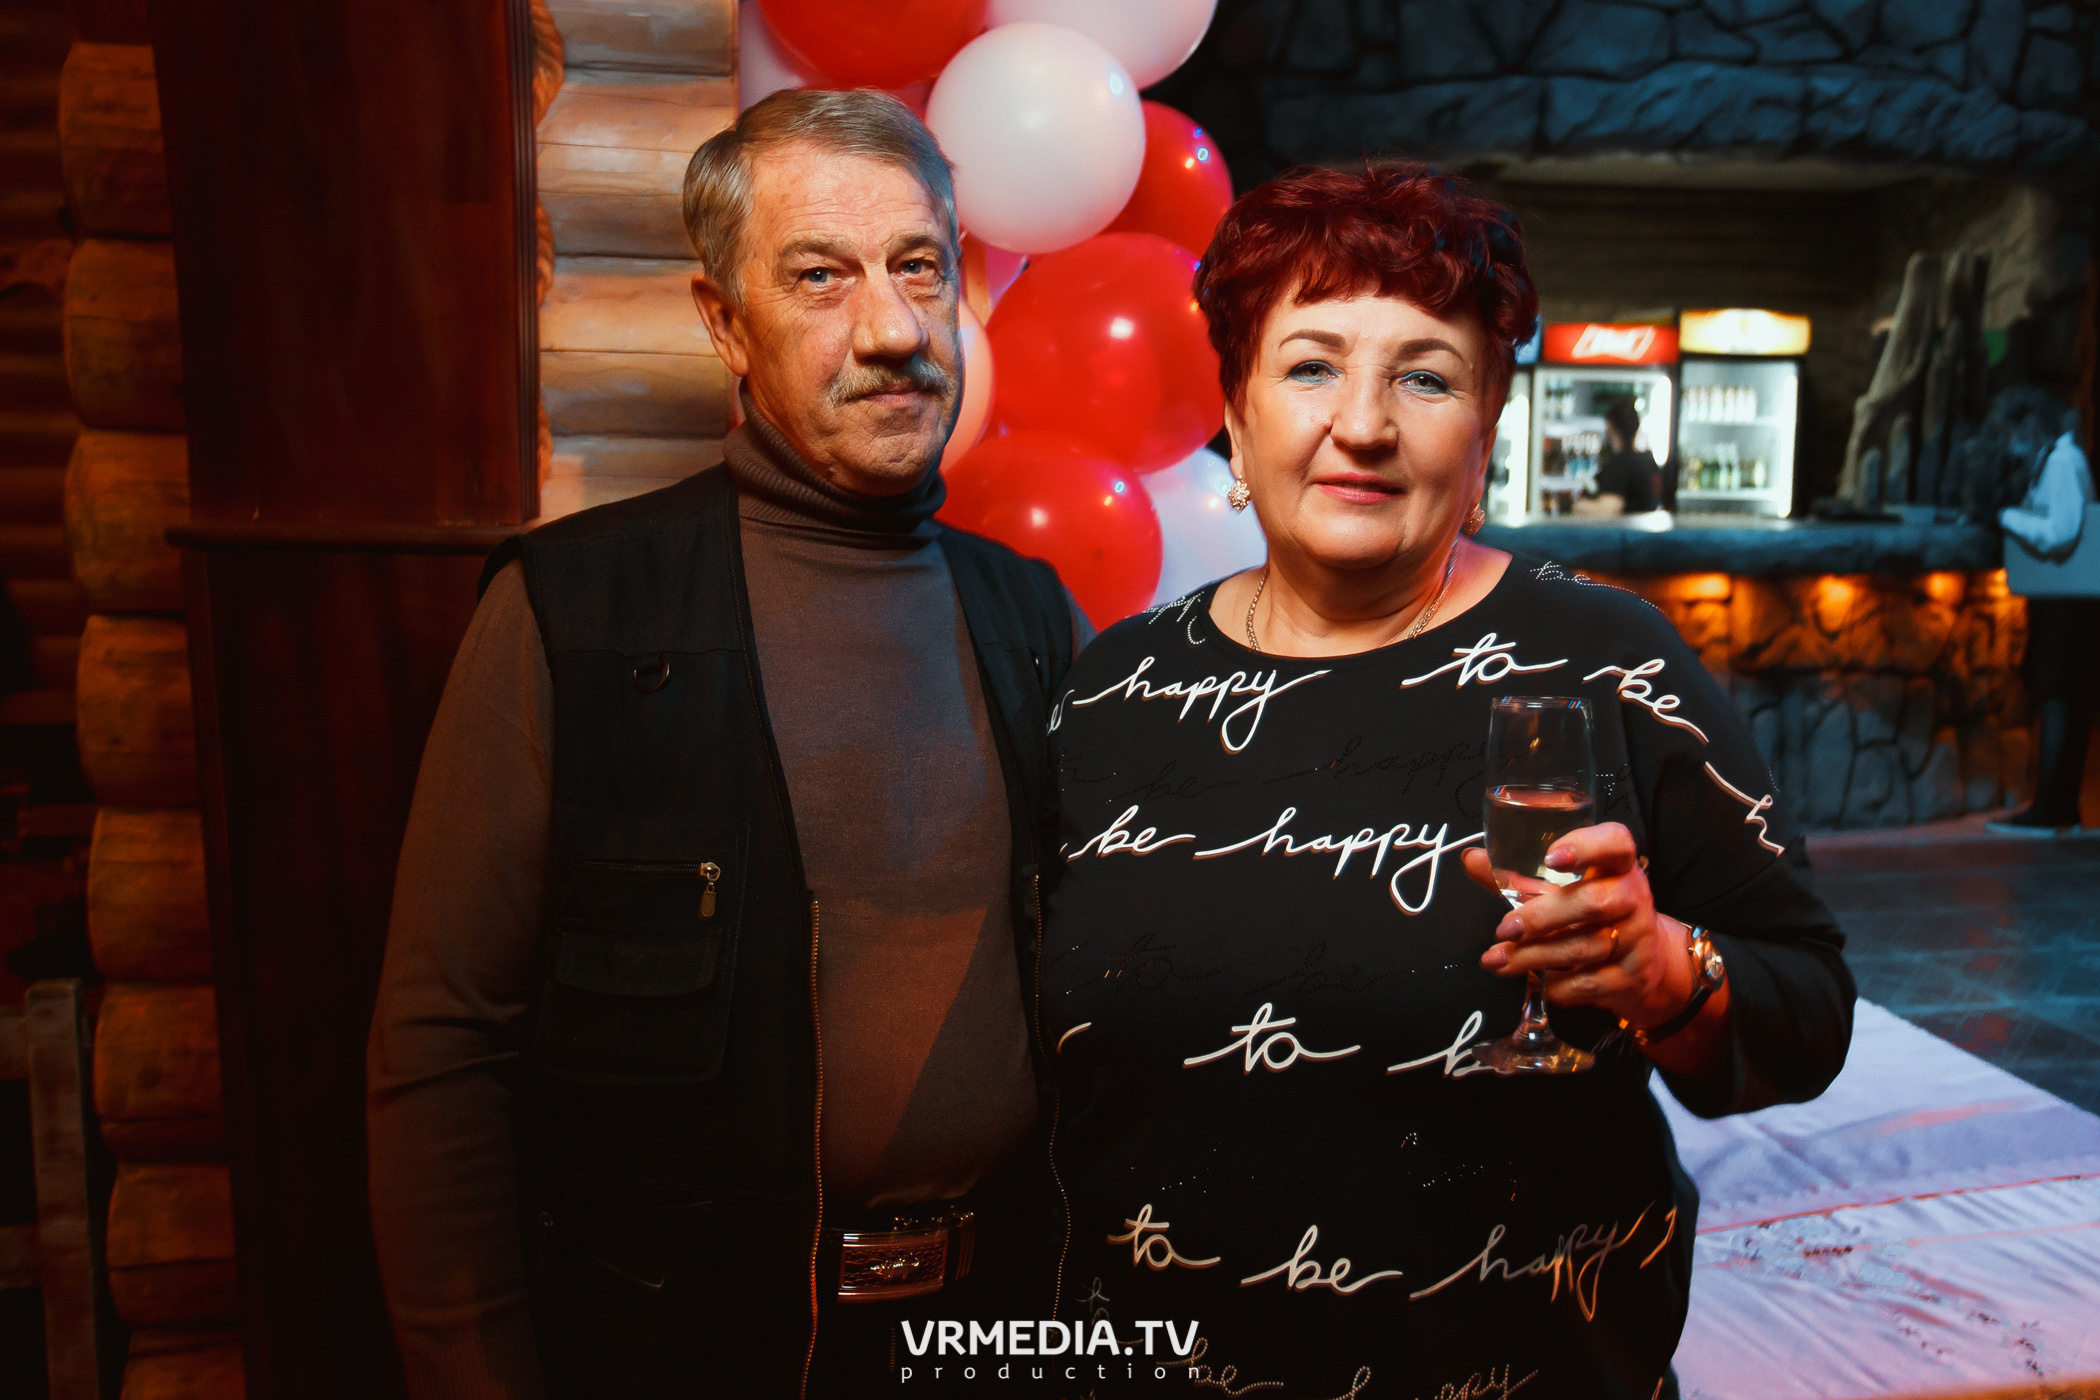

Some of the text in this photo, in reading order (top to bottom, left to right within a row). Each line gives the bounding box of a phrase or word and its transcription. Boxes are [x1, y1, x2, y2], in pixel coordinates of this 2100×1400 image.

[1072, 655, 1333, 754] happy
[1400, 632, 1568, 690] to
[1582, 658, 1710, 745] be
[1066, 805, 1485, 915] be happy
[1183, 1002, 1361, 1074] to
[1108, 1203, 1222, 1270] to
[1239, 1225, 1403, 1293] be
[1408, 1200, 1655, 1324] happy
